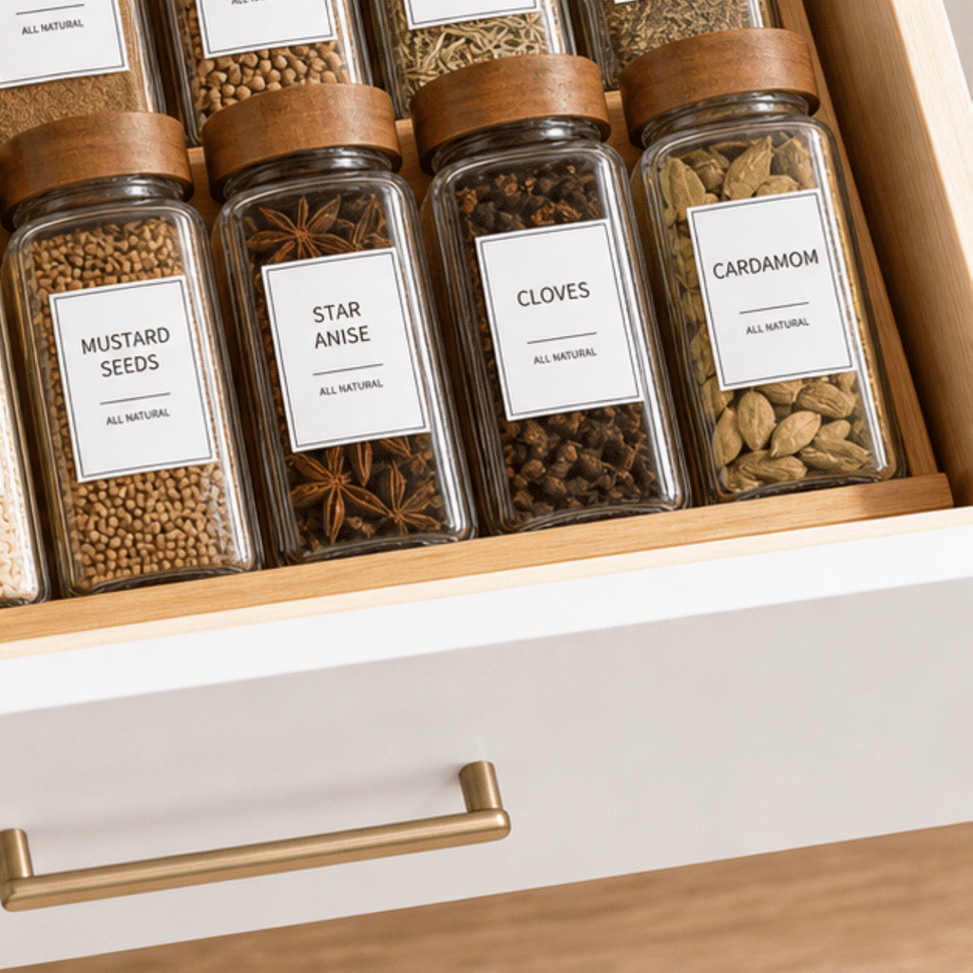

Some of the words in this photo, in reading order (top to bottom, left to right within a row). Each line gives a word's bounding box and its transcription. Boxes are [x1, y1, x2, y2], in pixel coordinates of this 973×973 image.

[21, 25, 39, 35] ALL
[40, 19, 84, 32] NATURAL
[712, 248, 819, 280] CARDAMOM
[516, 281, 590, 308] CLOVES
[312, 301, 362, 324] STAR
[314, 324, 371, 350] ANISE
[746, 325, 764, 335] ALL
[765, 318, 810, 331] NATURAL
[81, 326, 171, 355] MUSTARD
[100, 353, 160, 378] SEEDS
[533, 355, 551, 365] ALL
[552, 348, 597, 362] NATURAL
[319, 386, 337, 396] ALL
[338, 379, 383, 393] NATURAL
[106, 415, 124, 426] ALL
[125, 408, 170, 423] NATURAL
